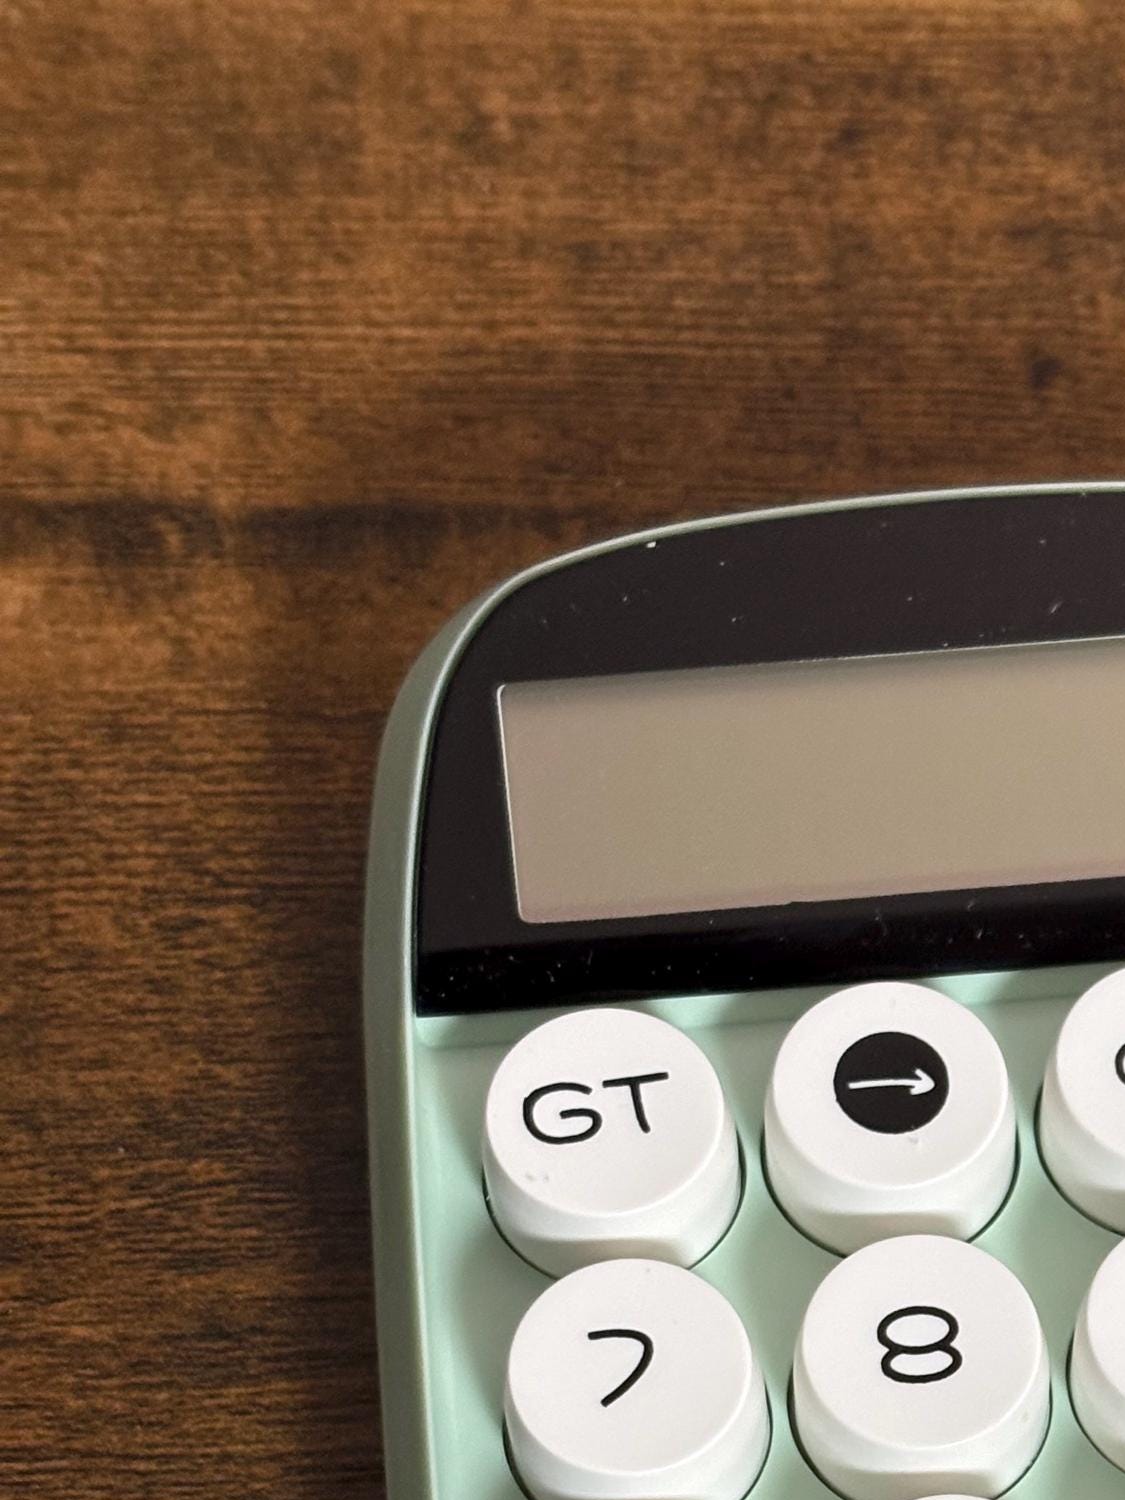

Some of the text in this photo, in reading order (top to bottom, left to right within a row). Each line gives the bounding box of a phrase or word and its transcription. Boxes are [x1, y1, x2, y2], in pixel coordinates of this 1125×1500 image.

[522, 1071, 669, 1145] GT
[587, 1328, 654, 1408] 7
[876, 1305, 963, 1385] 8
